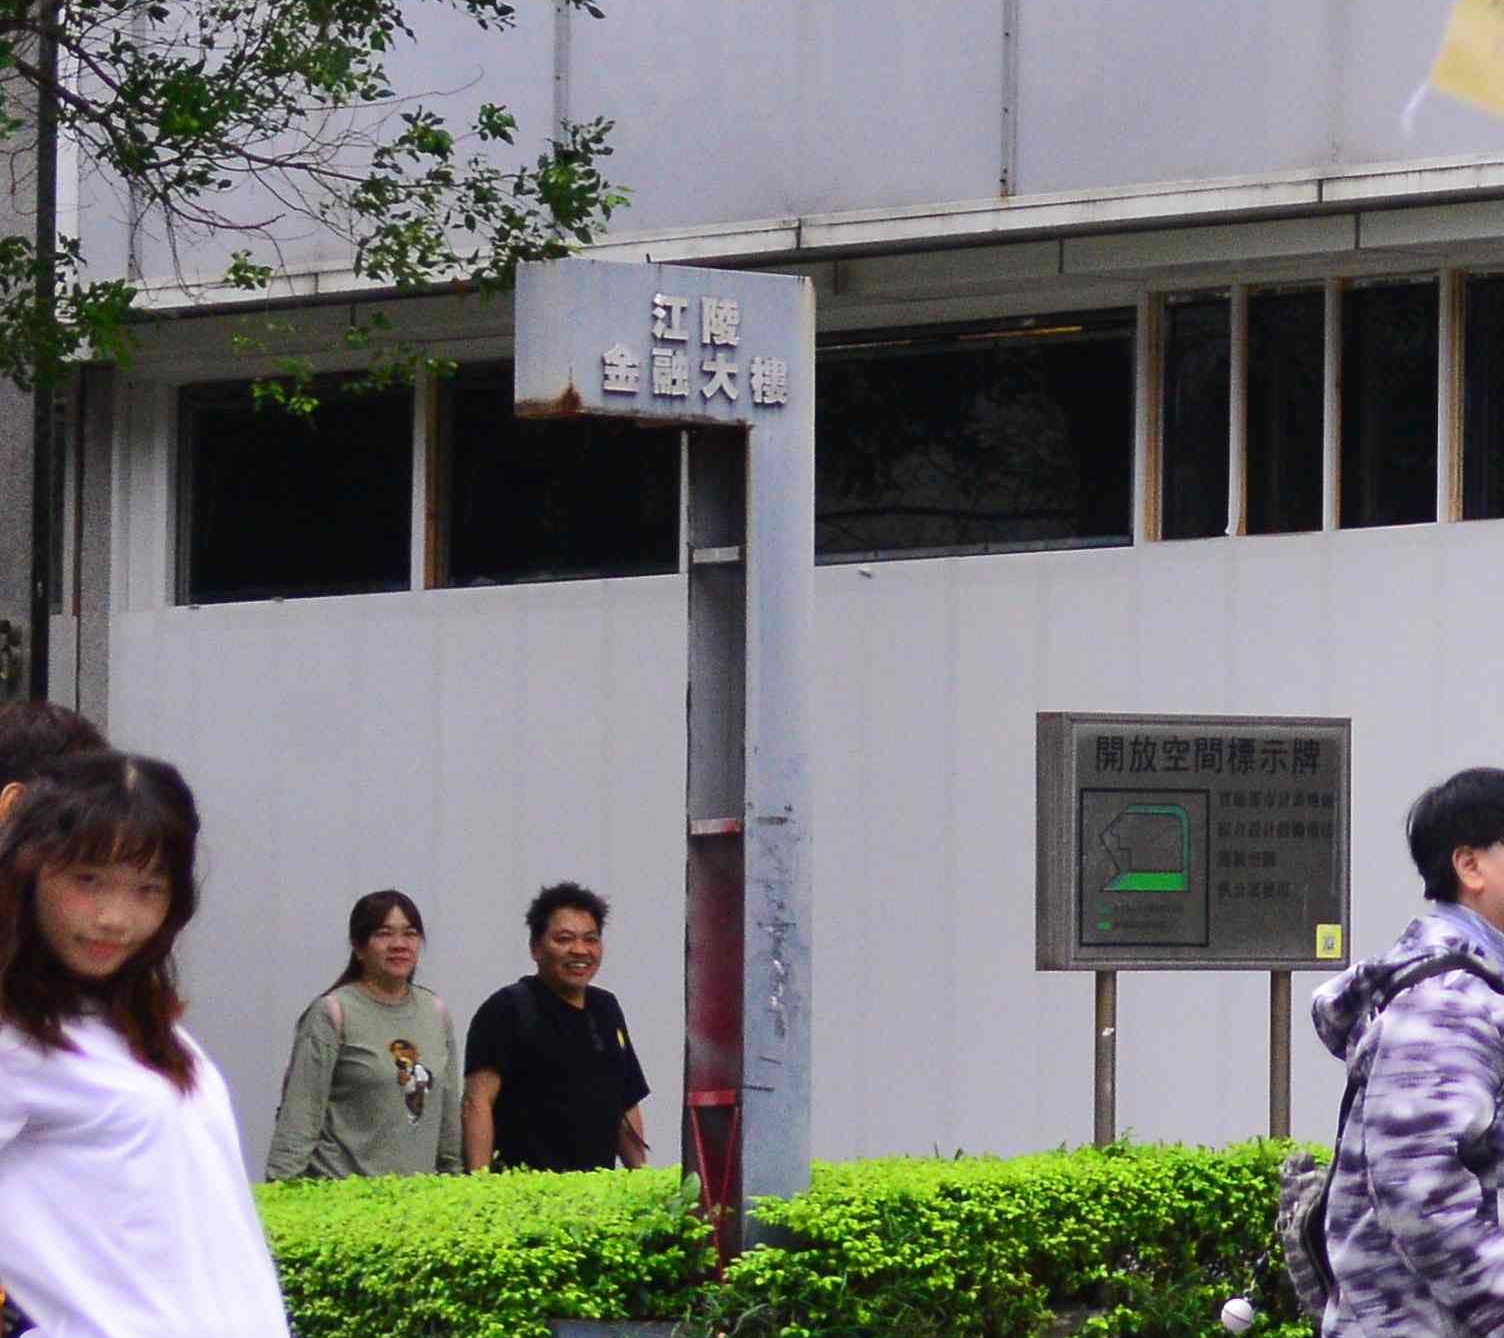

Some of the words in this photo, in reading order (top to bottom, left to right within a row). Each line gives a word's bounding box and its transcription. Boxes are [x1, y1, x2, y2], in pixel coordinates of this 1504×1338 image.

[602, 343, 788, 405] 金融大樓
[1094, 734, 1321, 776] 開放空間標示牌
